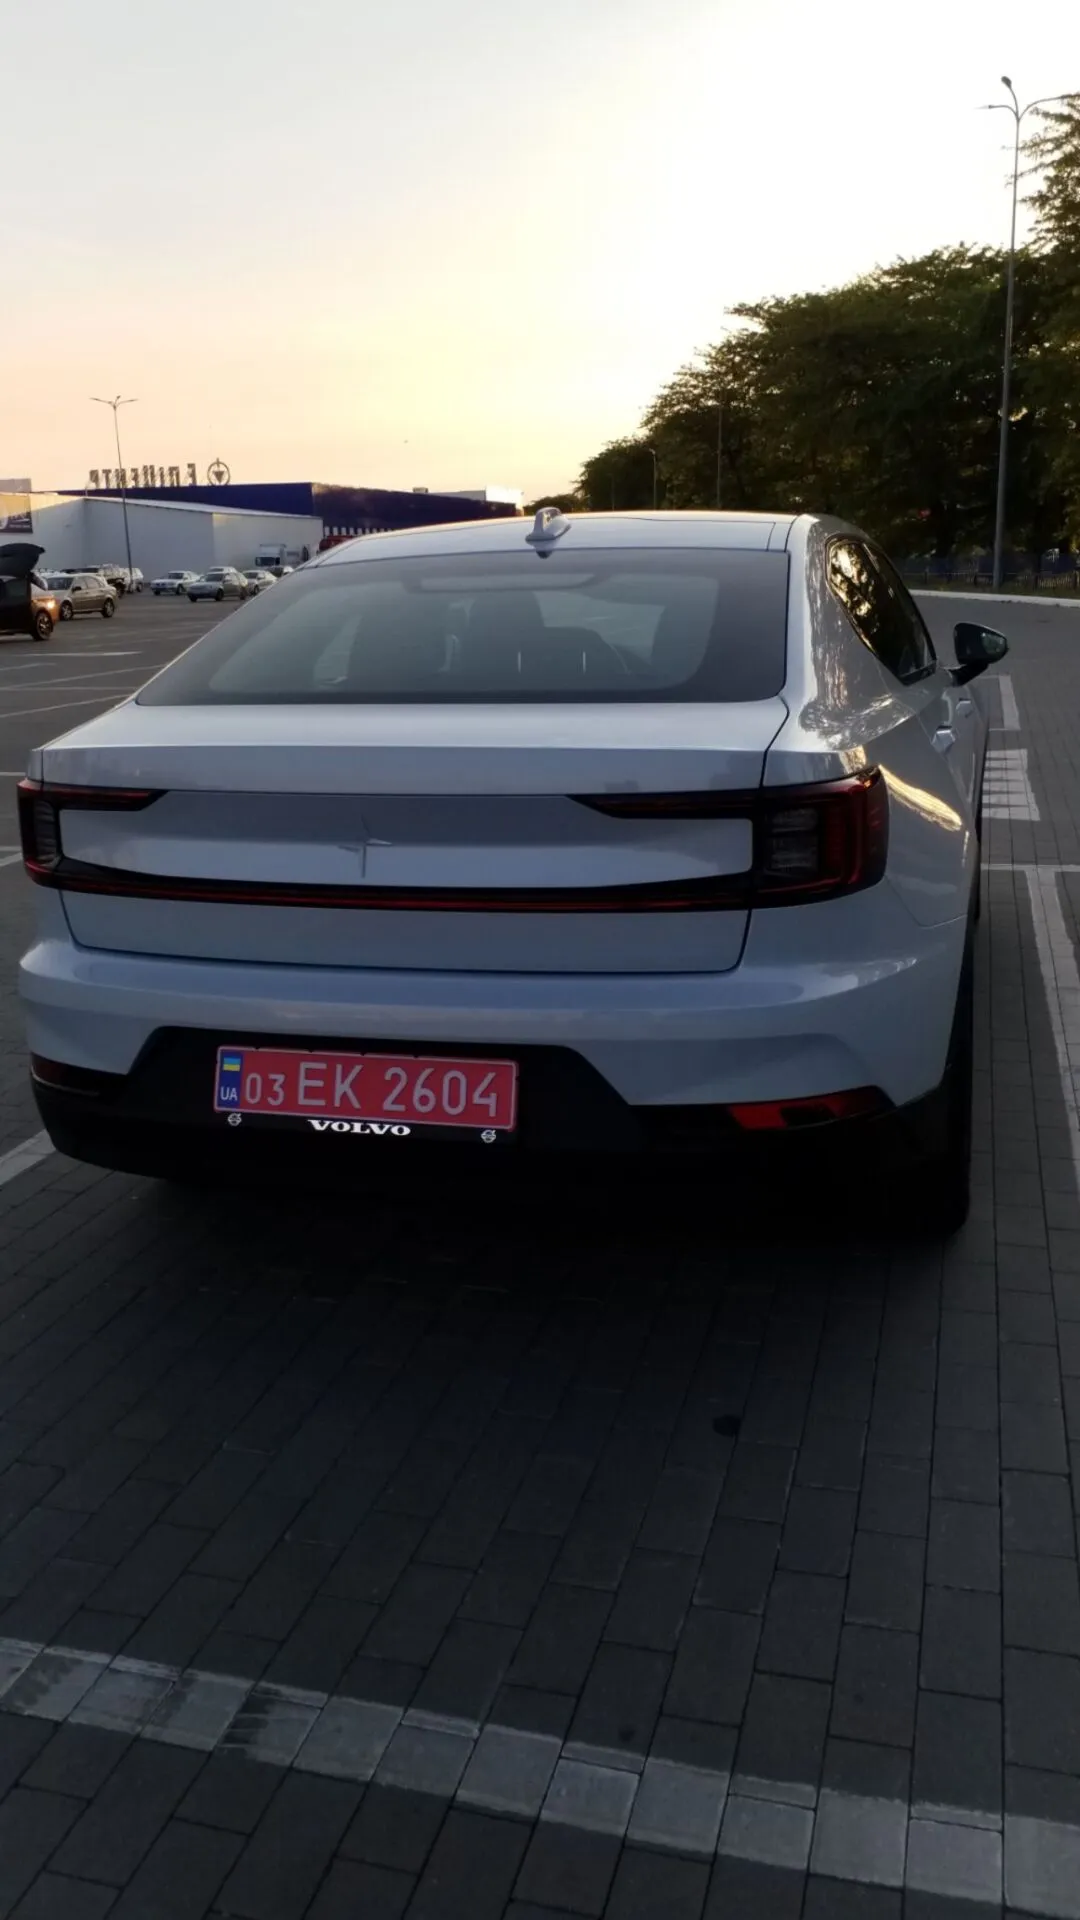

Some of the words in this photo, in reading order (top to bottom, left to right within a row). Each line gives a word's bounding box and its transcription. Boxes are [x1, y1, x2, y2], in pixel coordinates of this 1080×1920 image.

[220, 1087, 238, 1101] UA
[245, 1073, 285, 1105] 03
[298, 1061, 363, 1109] EK
[383, 1066, 497, 1117] 2604
[307, 1119, 412, 1136] VOLVO
